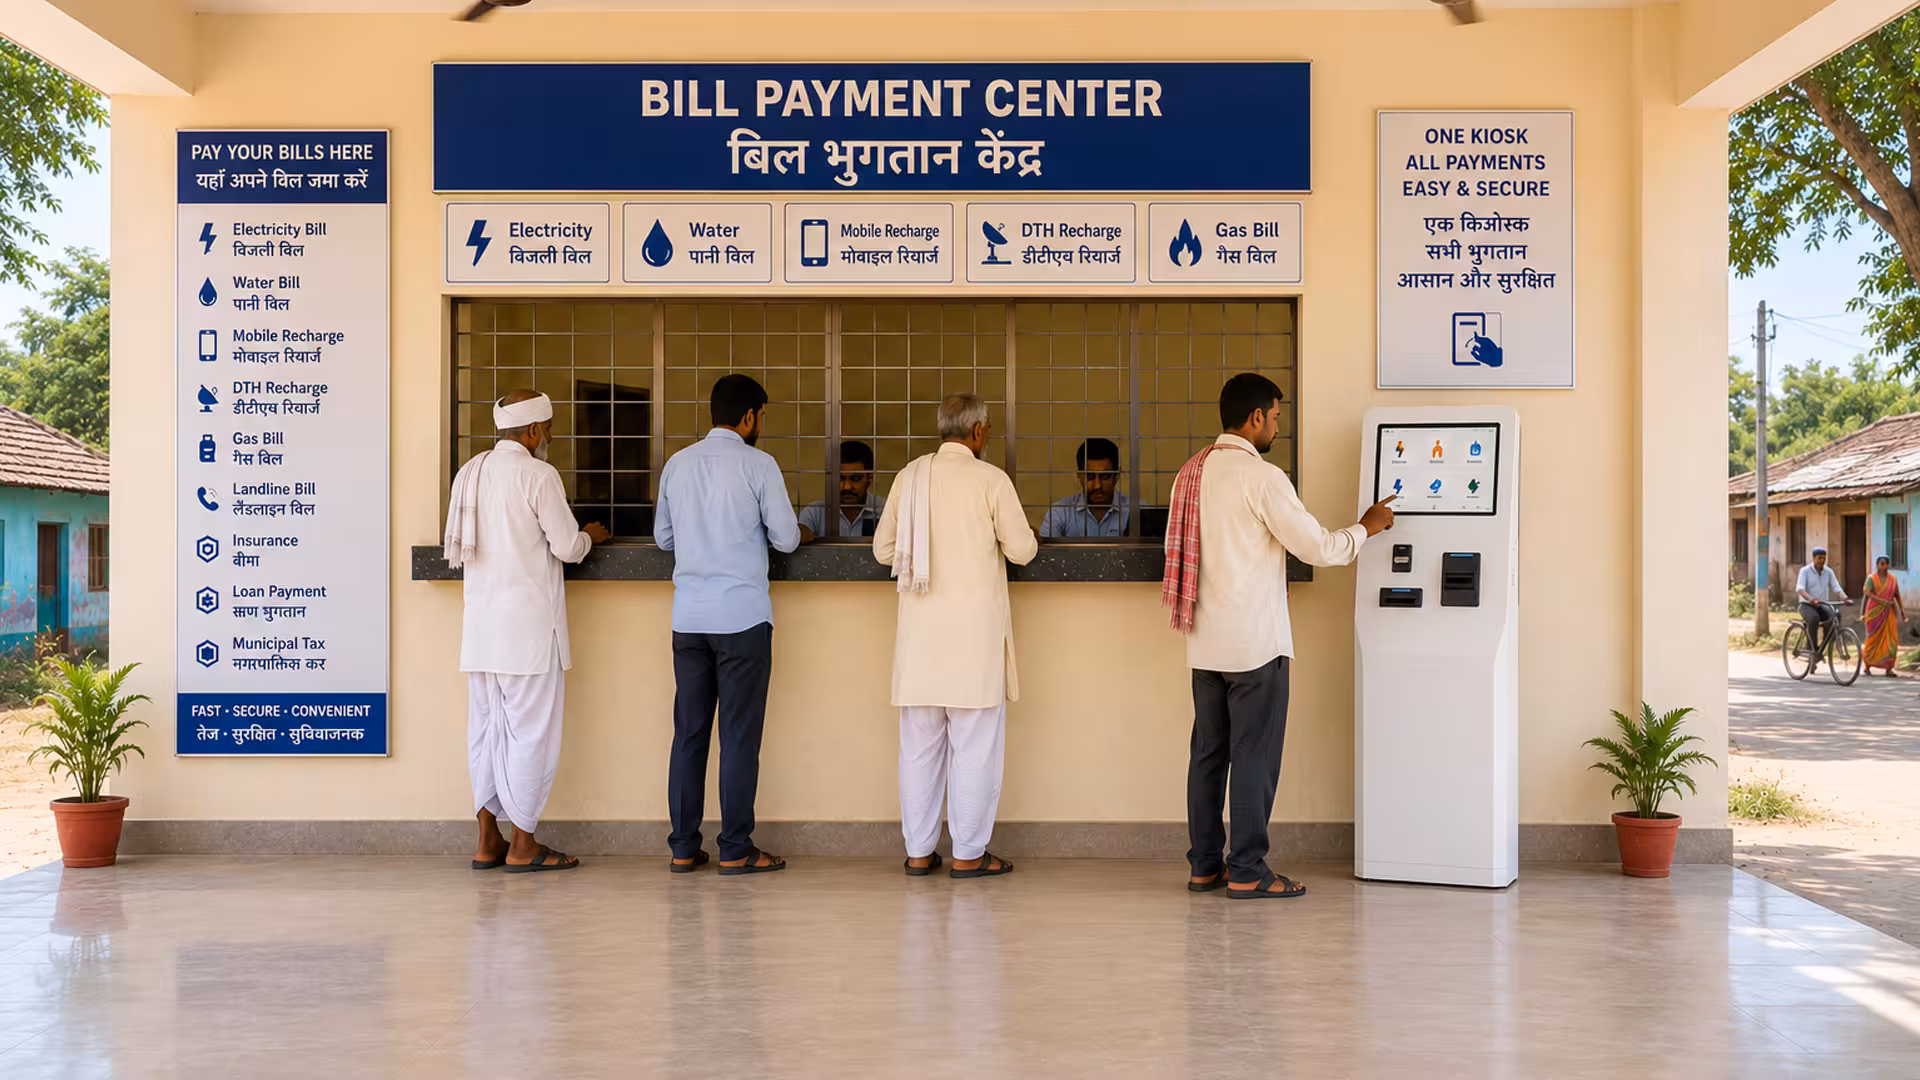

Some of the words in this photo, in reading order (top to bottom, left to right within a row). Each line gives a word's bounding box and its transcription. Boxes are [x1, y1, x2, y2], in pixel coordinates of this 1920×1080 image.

[642, 80, 739, 116] BILL
[757, 80, 970, 116] PAYMENT
[985, 79, 1162, 117] CENTER
[1425, 129, 1464, 144] ONE
[1472, 128, 1528, 144] KIOSK
[192, 145, 222, 160] PAY
[227, 144, 273, 160] YOUR
[279, 144, 324, 160] BILLS
[330, 144, 373, 160] HERE
[727, 128, 810, 174] बिल
[823, 141, 962, 186] भुगतान
[975, 128, 1045, 177] केंद्र
[1406, 155, 1440, 170] ALL
[1447, 155, 1545, 170] PAYMENTS
[230, 169, 268, 188] अपने
[307, 174, 340, 188] जमा
[343, 169, 368, 188] करें
[1403, 181, 1451, 196] EASY
[1457, 181, 1469, 196] &
[1477, 181, 1549, 196] SECURE
[234, 223, 301, 239] Electricity
[306, 223, 326, 235] Bill
[510, 222, 592, 241] Electricity
[689, 222, 740, 237] Water
[841, 223, 881, 237] Mobile
[885, 224, 939, 241] Recharge
[1022, 223, 1054, 237] DTH
[1060, 223, 1121, 241] Recharge
[1216, 222, 1247, 237] Gas
[1254, 222, 1278, 237] Bill
[1423, 218, 1455, 235] एक
[689, 245, 720, 263] पानी
[1425, 239, 1462, 260] सभी
[1468, 245, 1528, 265] भुगतान
[233, 276, 274, 289] Water
[279, 276, 300, 288] Bill
[1398, 273, 1454, 288] आसान
[1460, 267, 1492, 288] और
[1497, 268, 1556, 294] सुरक्षित
[233, 295, 260, 310] पानी
[234, 329, 278, 342] Mobile
[283, 329, 344, 345] Recharge
[233, 381, 261, 394] DTH
[266, 381, 328, 397] Recharge
[233, 432, 258, 444] Gas
[263, 432, 283, 444] Bill
[234, 483, 290, 495] Landline
[295, 482, 315, 495] Bill
[234, 534, 298, 546] Insurance
[233, 585, 264, 597] Loan
[269, 585, 326, 600] Payment
[233, 637, 298, 653] Municipal
[302, 637, 325, 649] Tax
[305, 659, 326, 670] कर
[192, 705, 221, 717] FAST
[233, 705, 280, 717] SECURE
[292, 705, 371, 717] CONVENIENT
[196, 724, 220, 740] तेज
[232, 724, 277, 745] सुरक्षित
